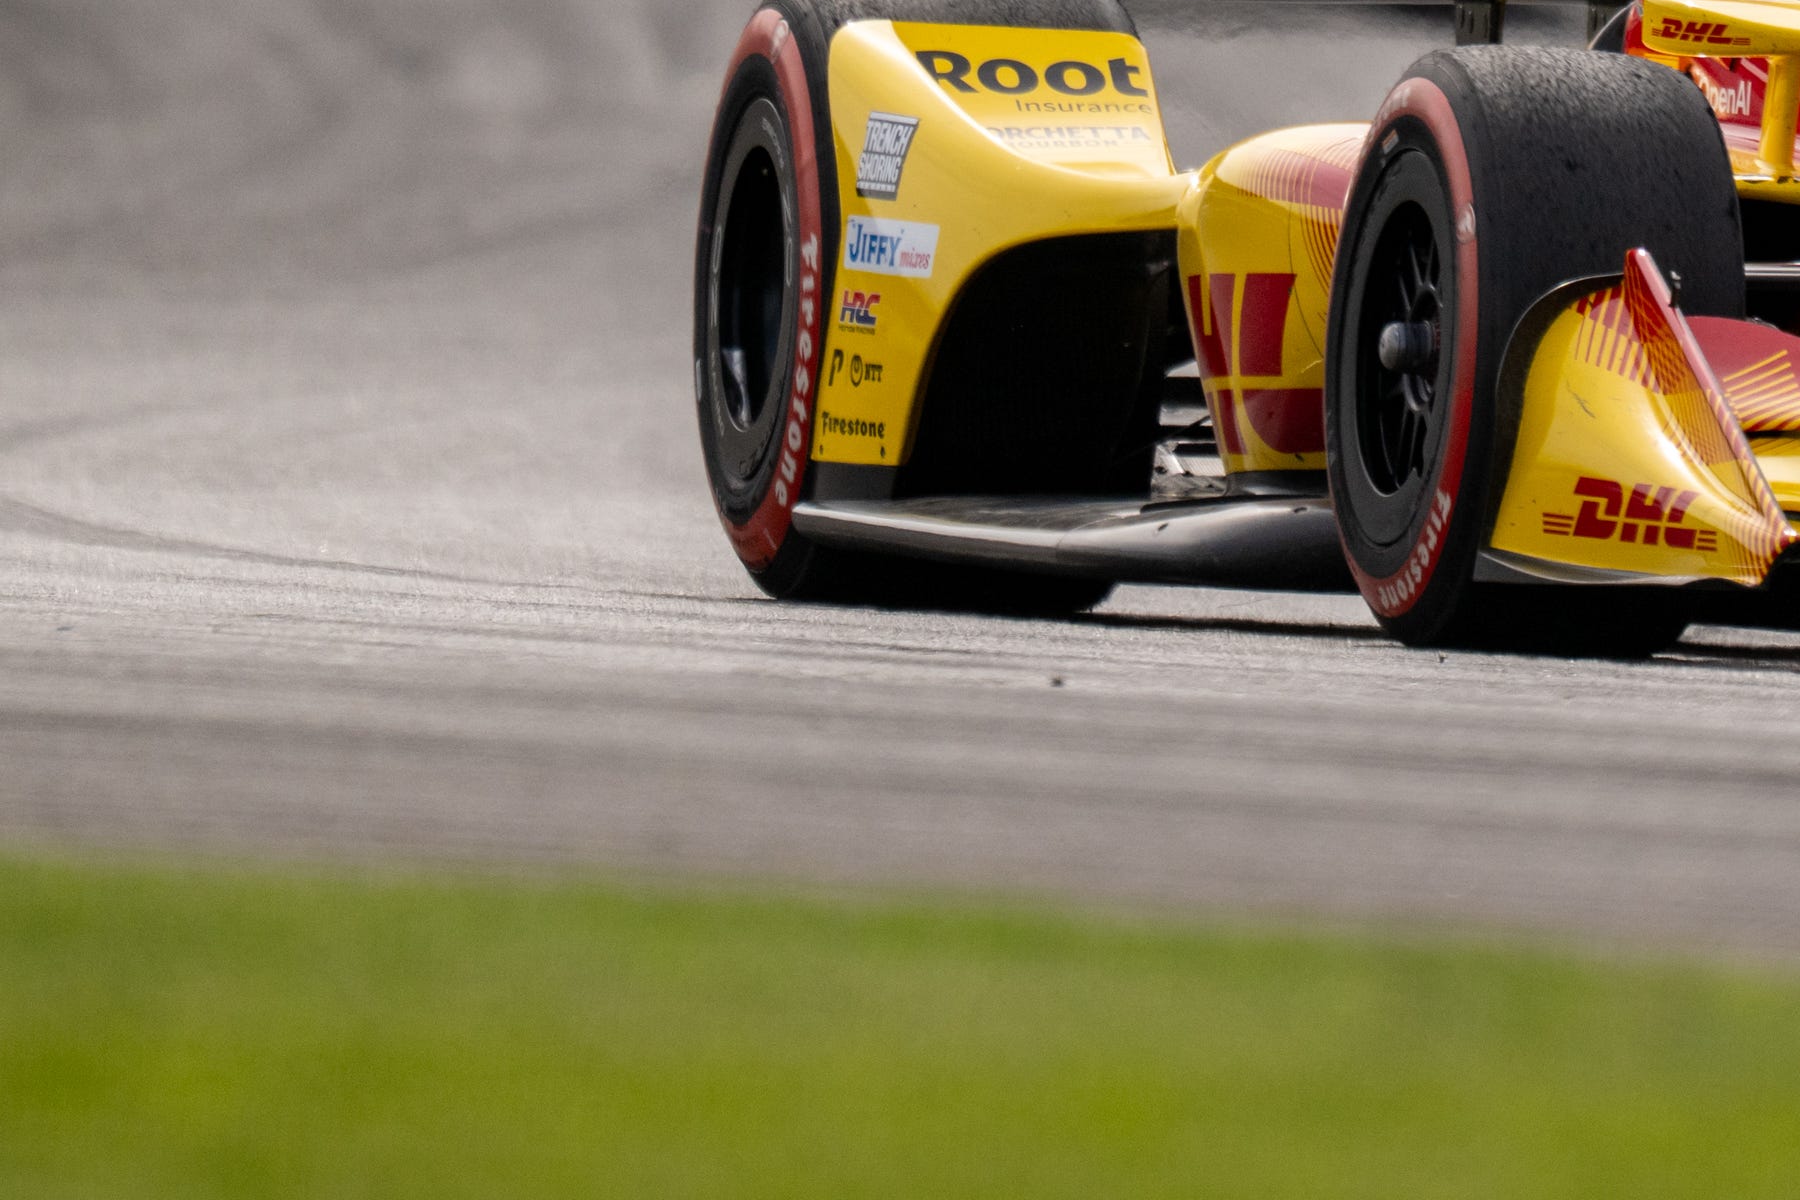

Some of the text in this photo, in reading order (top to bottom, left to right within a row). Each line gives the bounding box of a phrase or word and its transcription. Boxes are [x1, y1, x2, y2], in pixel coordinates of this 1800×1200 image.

[1661, 18, 1734, 45] DHL
[915, 50, 1149, 97] Root
[1014, 99, 1153, 115] Insurance
[863, 119, 914, 155] TRENCH
[858, 151, 901, 184] SHORING
[775, 232, 818, 507] Firestone
[864, 363, 883, 383] NTT
[822, 411, 886, 440] Firestone
[1573, 476, 1700, 549] DHL
